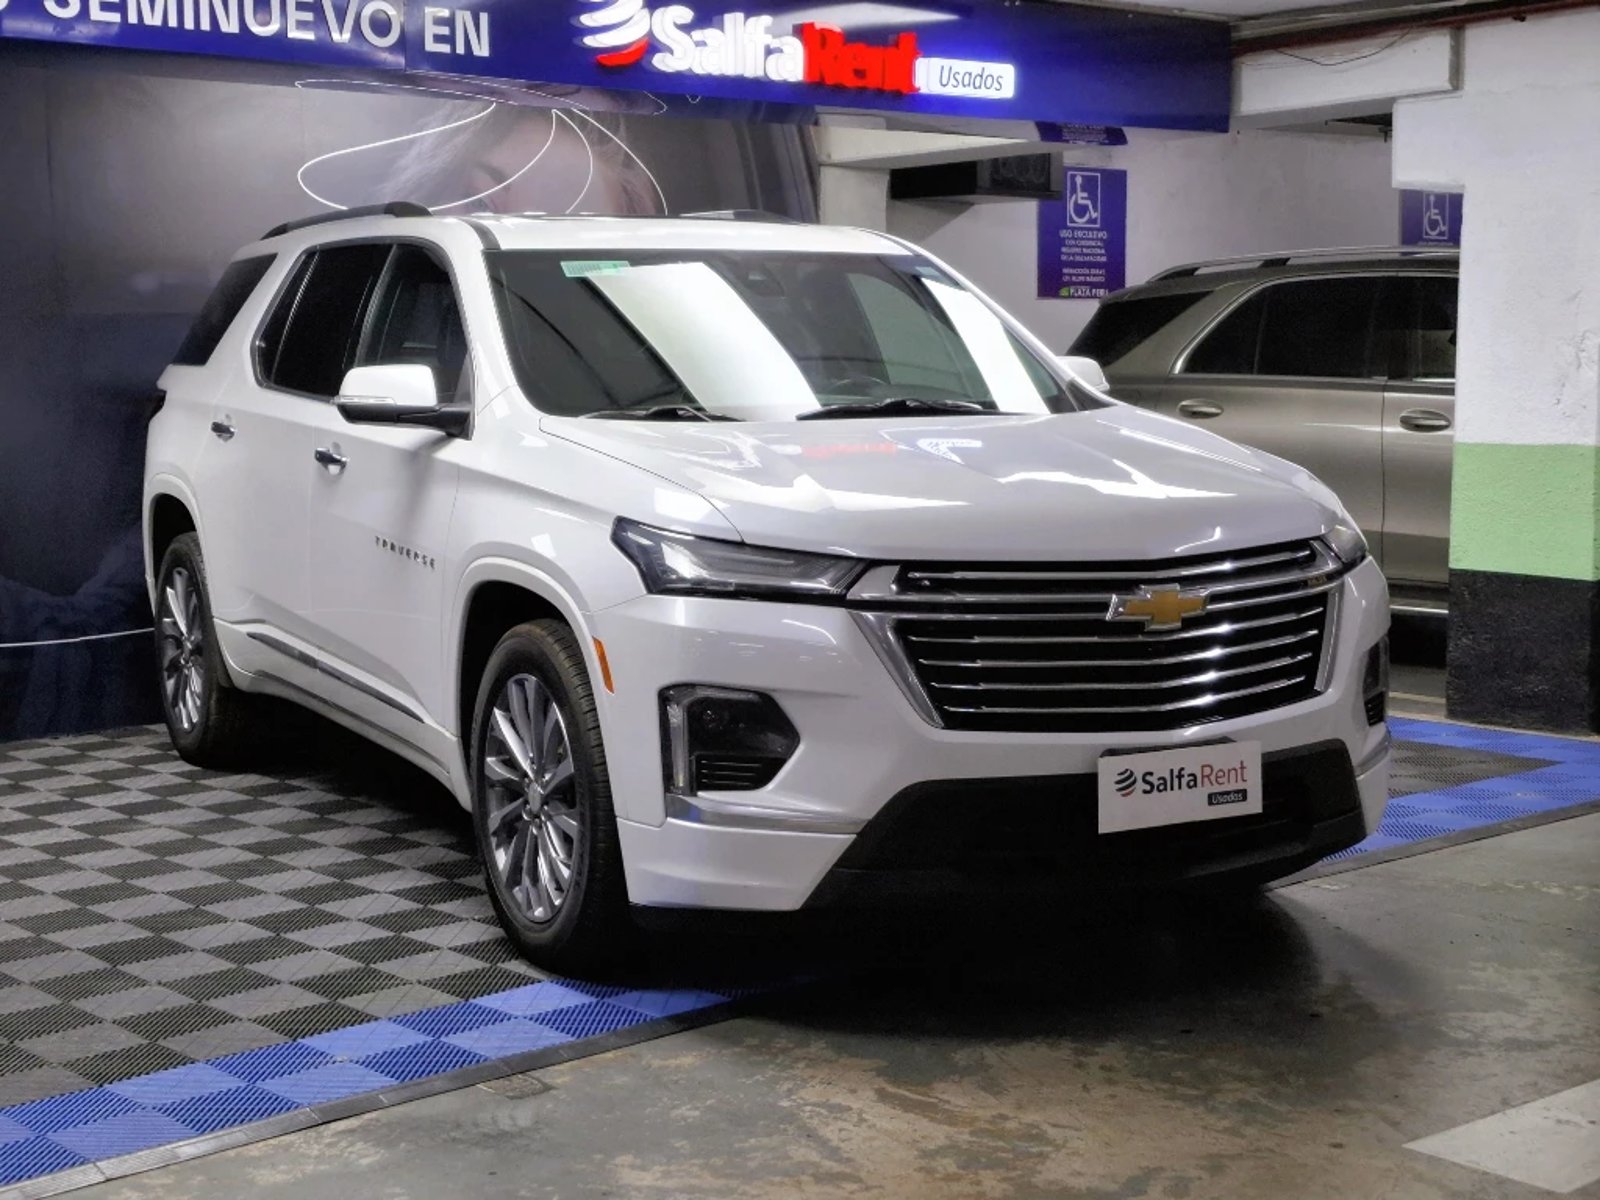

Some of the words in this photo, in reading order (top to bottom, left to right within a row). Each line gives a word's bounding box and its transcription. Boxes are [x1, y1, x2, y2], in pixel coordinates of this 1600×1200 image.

[424, 7, 490, 57] EN
[651, 4, 922, 94] SalfaRent
[938, 64, 1004, 92] Usados
[1141, 760, 1248, 795] SalfaRent
[1211, 791, 1244, 804] Usados
